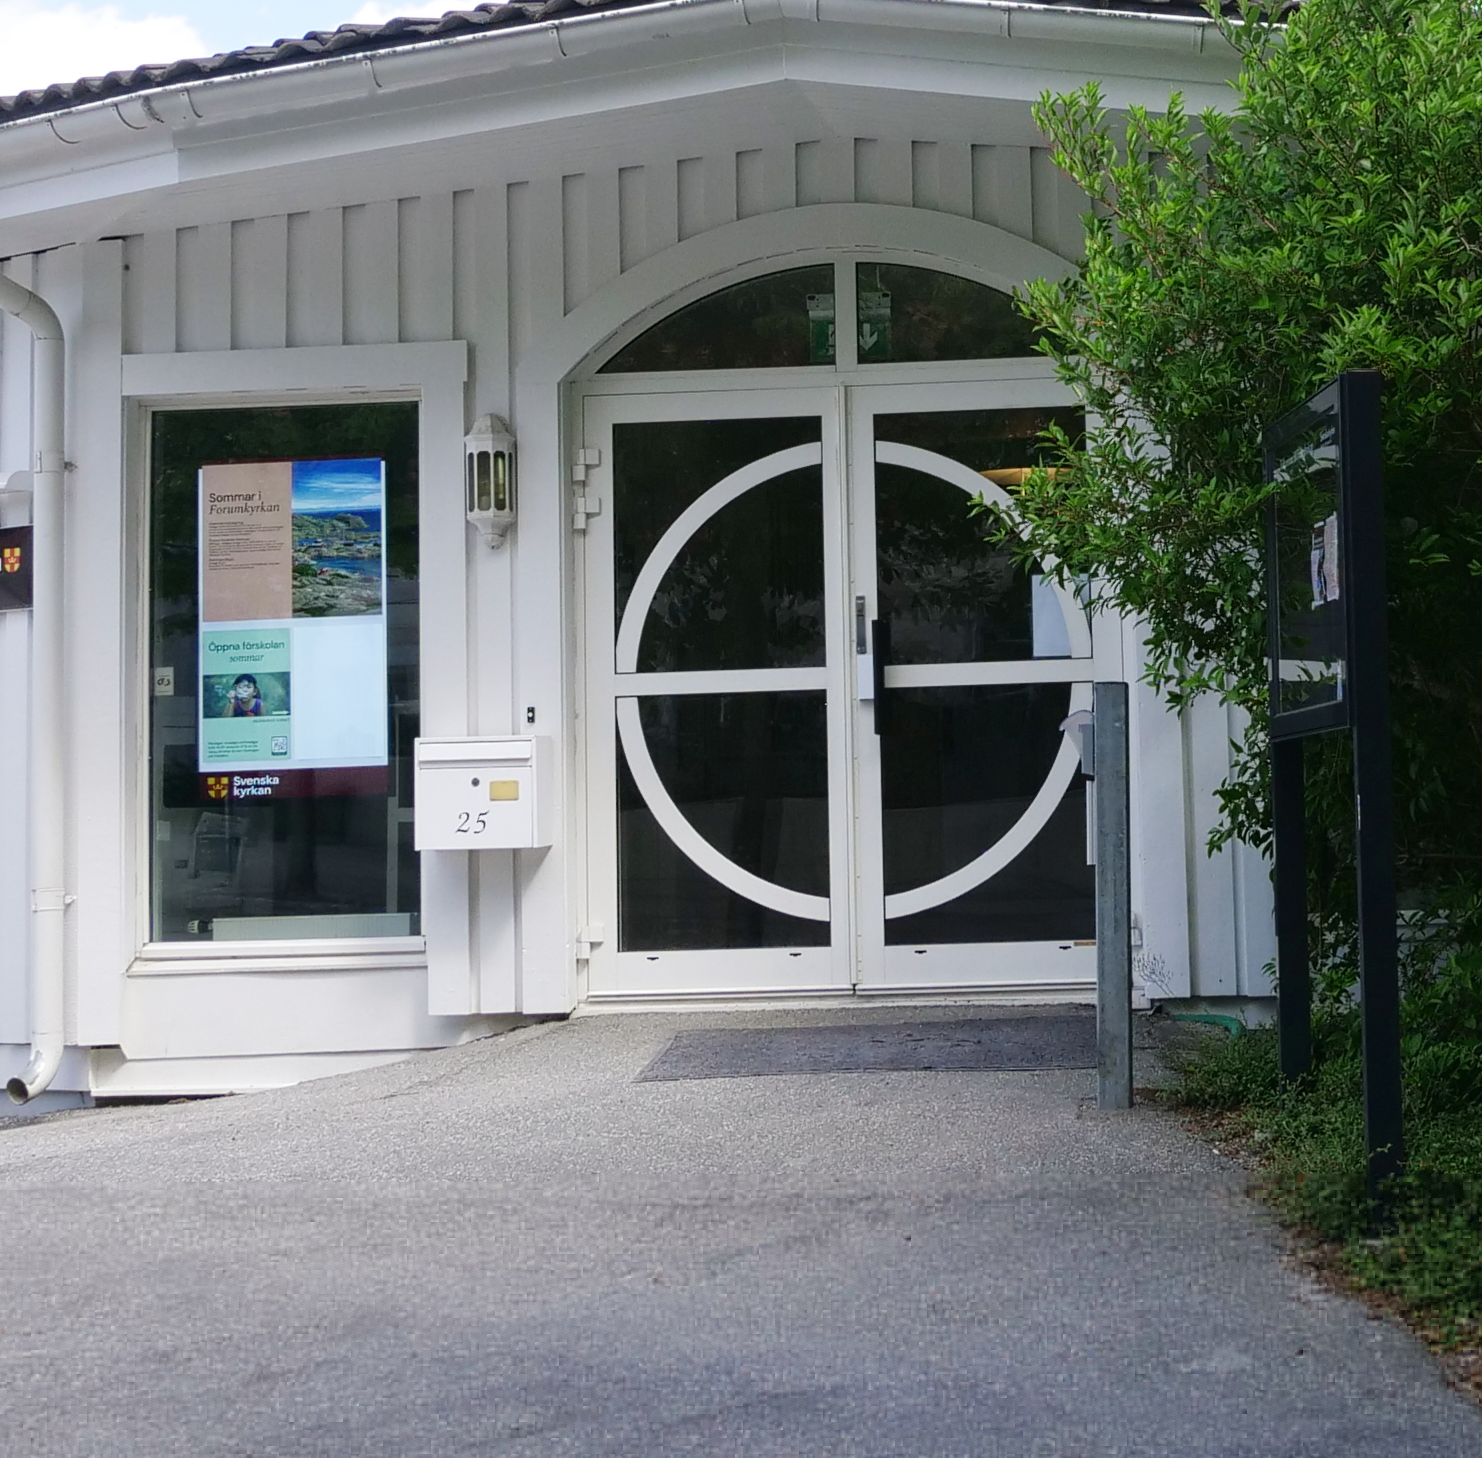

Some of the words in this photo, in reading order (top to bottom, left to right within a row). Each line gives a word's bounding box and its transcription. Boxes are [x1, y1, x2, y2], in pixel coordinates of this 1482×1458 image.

[209, 493, 255, 503] Sommar
[209, 501, 280, 516] Forumkyrkan
[208, 641, 240, 654] Öppna
[242, 640, 285, 650] förskolan
[229, 654, 265, 663] sommar
[233, 774, 279, 786] Svenska
[233, 785, 271, 798] kyrkan
[455, 810, 490, 834] 25
